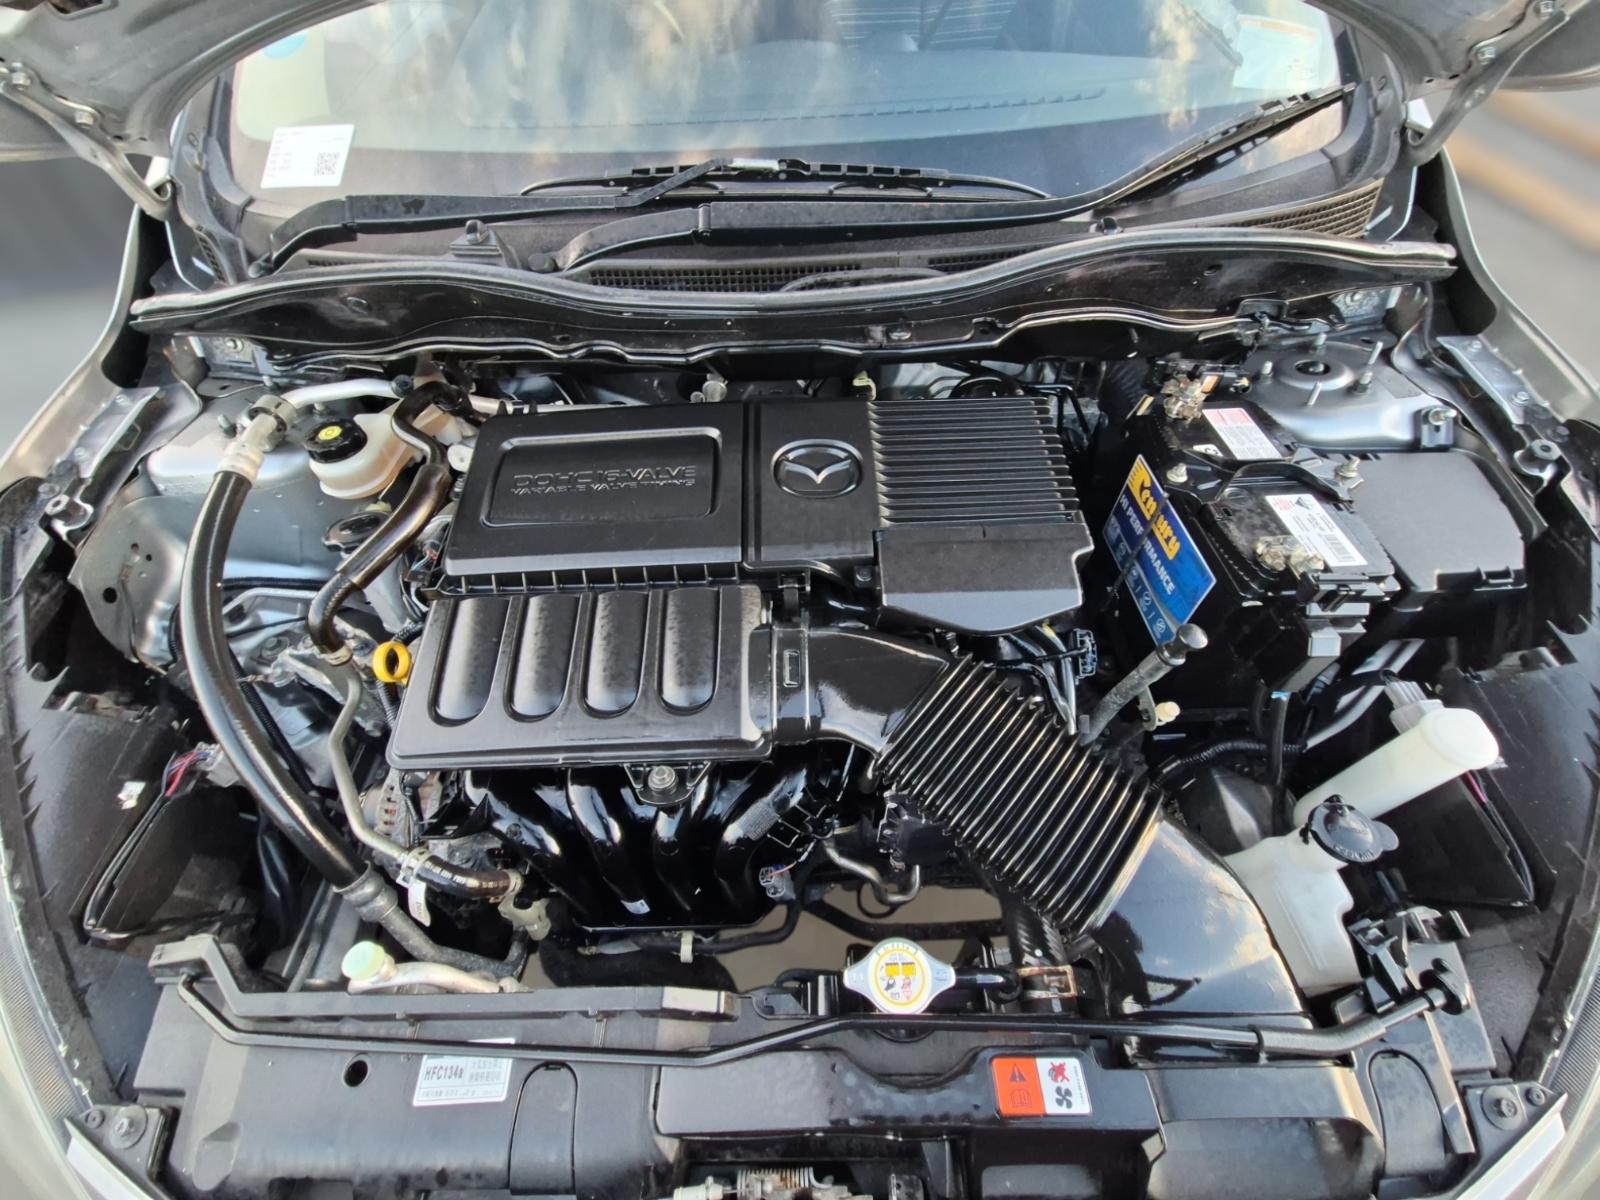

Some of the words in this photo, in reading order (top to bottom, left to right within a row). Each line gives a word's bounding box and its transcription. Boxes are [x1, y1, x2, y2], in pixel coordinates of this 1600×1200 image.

[513, 471, 593, 486] DOHC
[597, 465, 697, 481] 16-VALVE
[1125, 506, 1176, 596] PERFRMANCE
[423, 1065, 464, 1082] HFC134a
